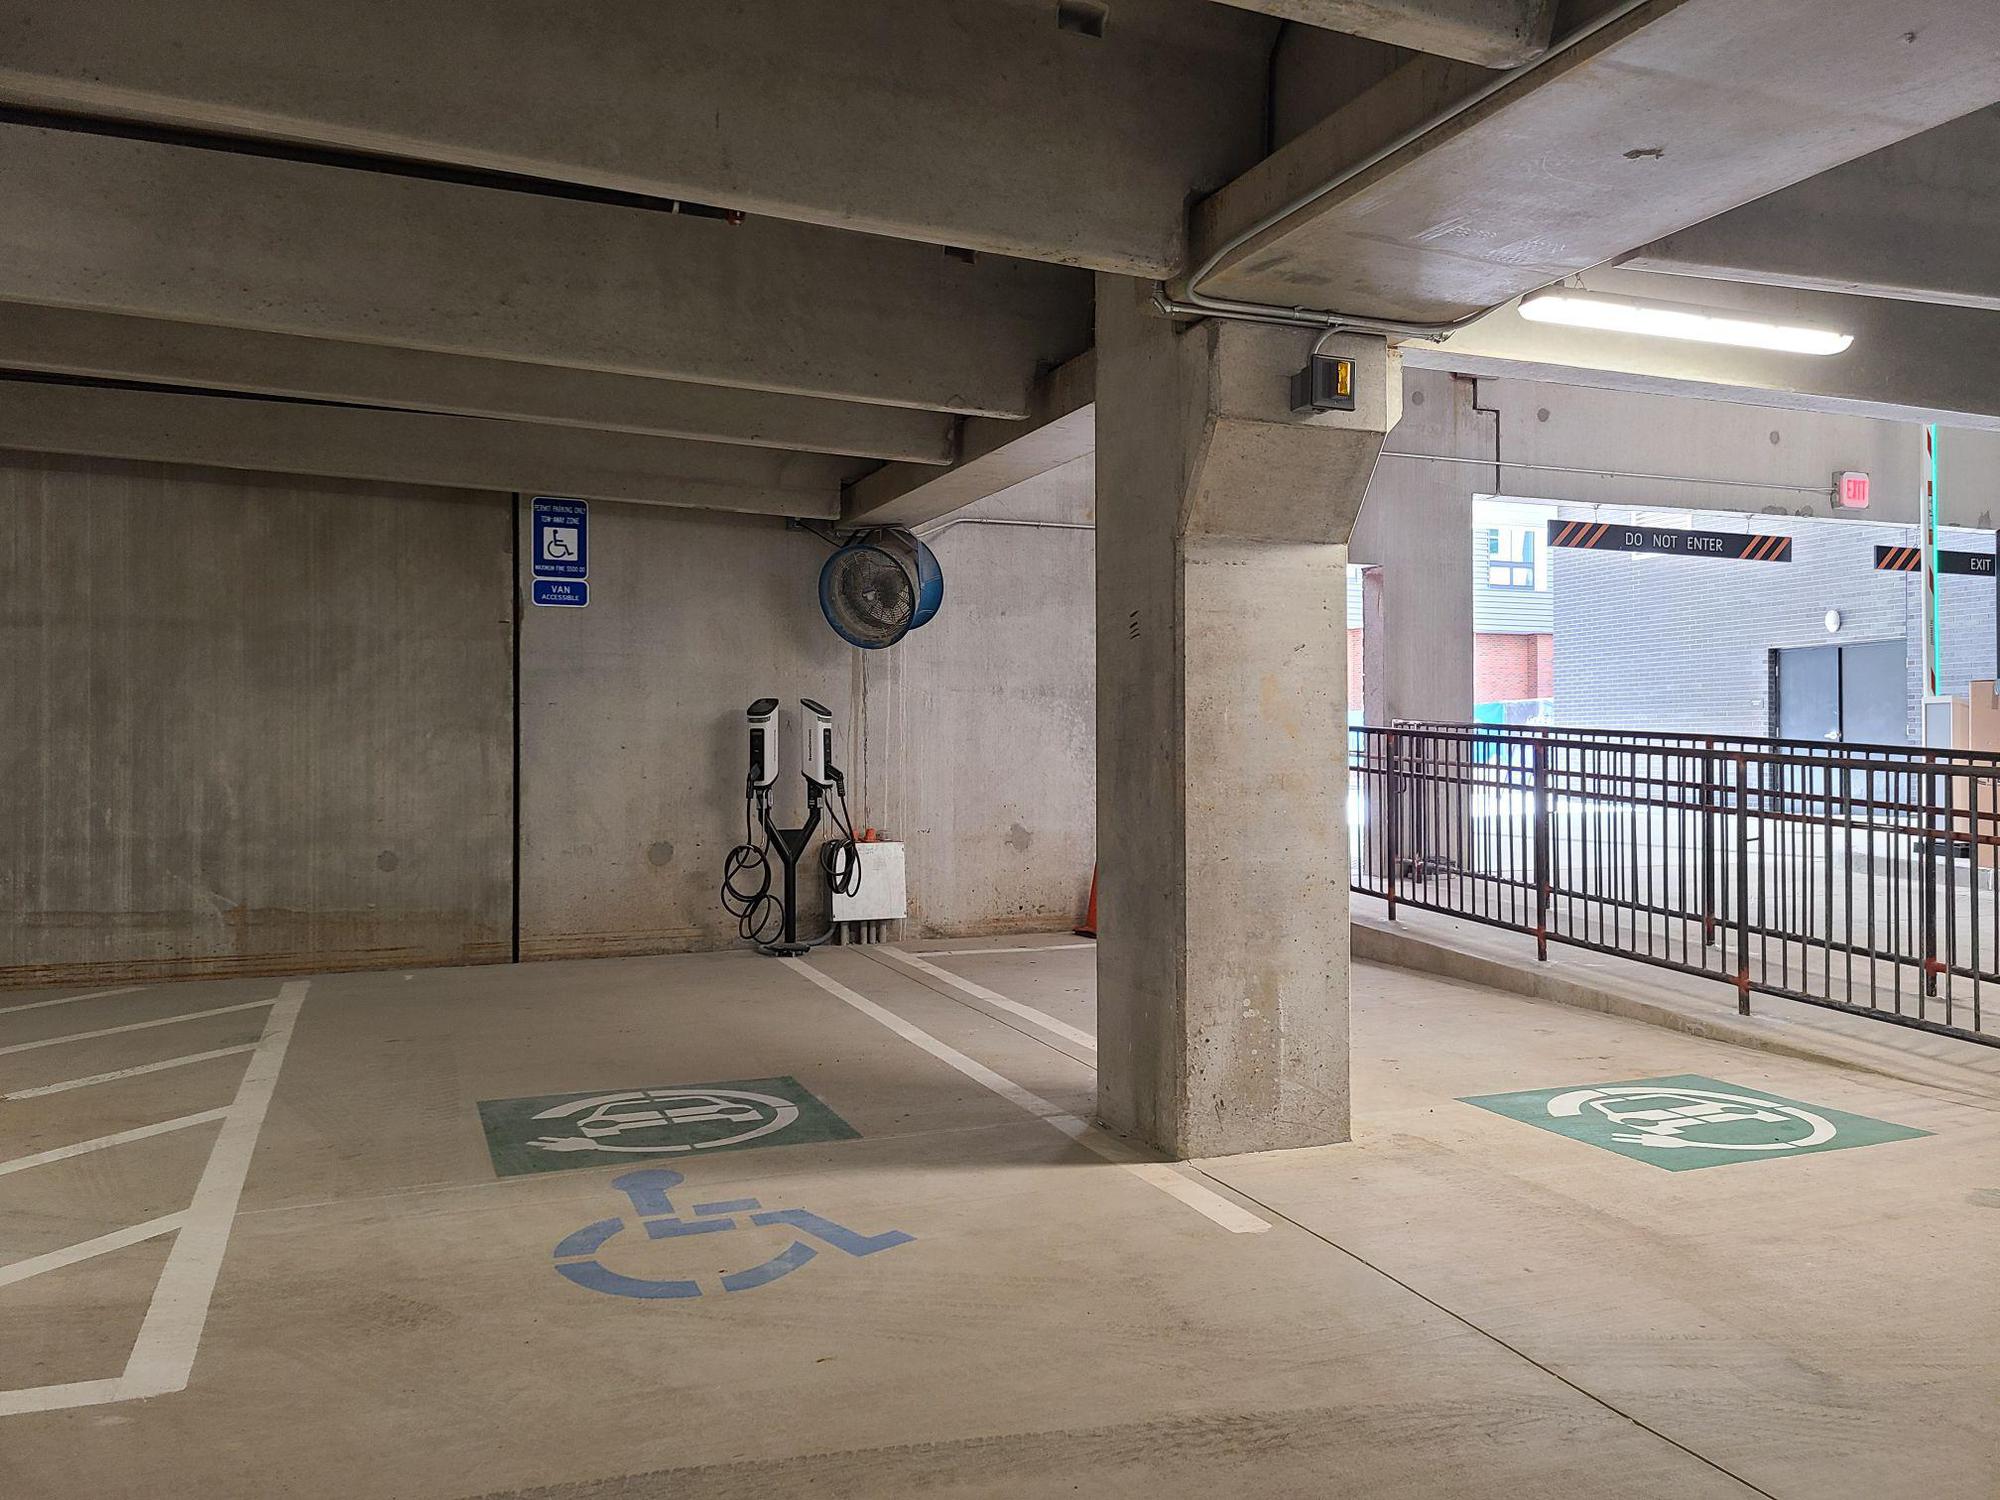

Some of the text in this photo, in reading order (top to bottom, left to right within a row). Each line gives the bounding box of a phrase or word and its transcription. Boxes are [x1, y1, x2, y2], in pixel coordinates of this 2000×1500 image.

[1847, 479, 1867, 501] EXIT
[1625, 532, 1723, 552] DO NOT ENTER
[1970, 557, 1991, 571] EXIT
[551, 585, 571, 594] VAN
[541, 593, 580, 601] ACCESSIBLE
